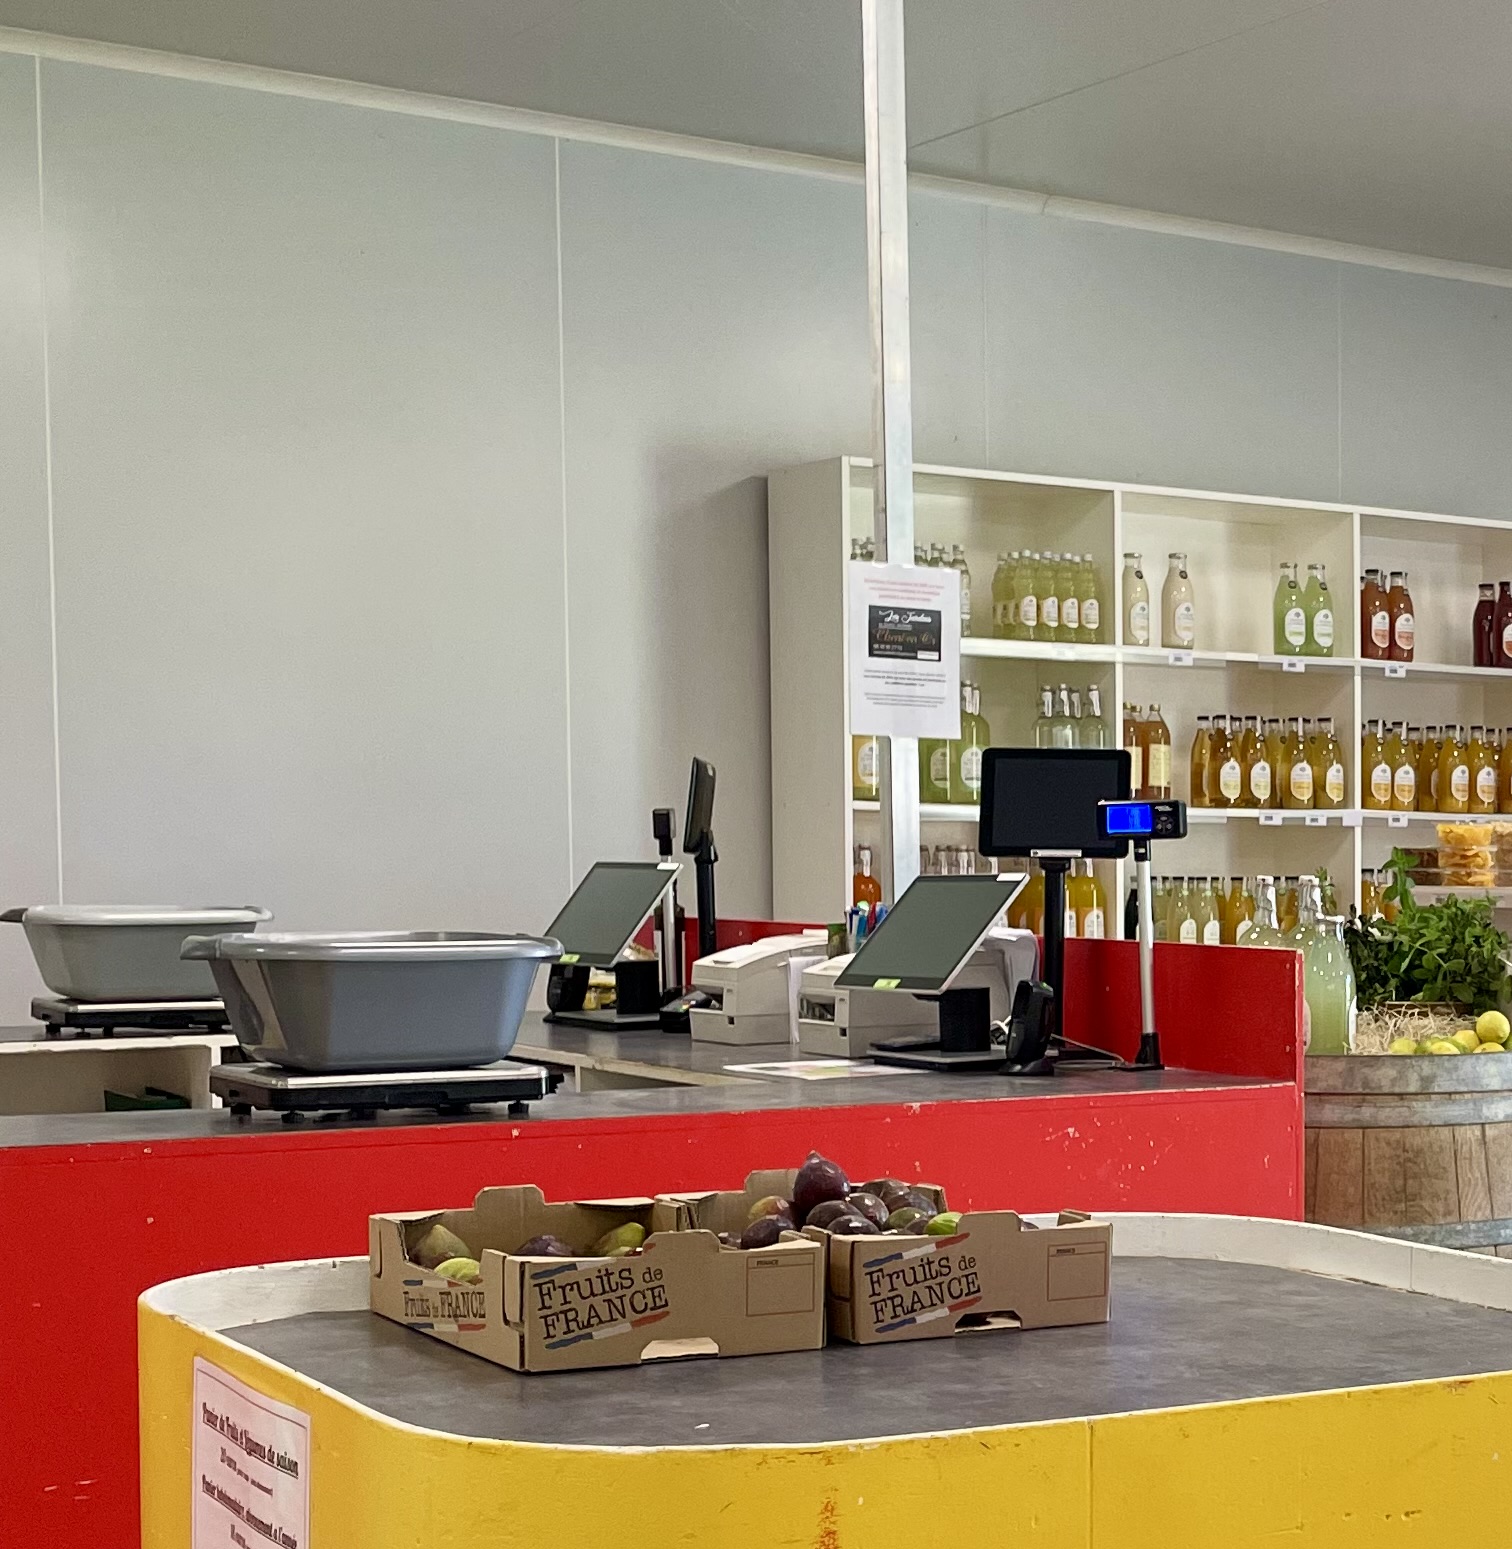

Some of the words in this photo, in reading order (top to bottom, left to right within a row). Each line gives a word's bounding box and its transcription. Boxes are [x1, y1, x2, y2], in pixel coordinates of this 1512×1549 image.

[532, 1266, 635, 1312] Fruits
[642, 1266, 664, 1284] de
[864, 1254, 952, 1299] Fruits
[957, 1254, 977, 1272] de
[869, 1272, 982, 1325] FRANCE
[402, 1291, 430, 1318] Fruits
[438, 1291, 486, 1319] FRANCE
[538, 1284, 670, 1340] FRANCE
[267, 1445, 275, 1465] de
[276, 1451, 298, 1477] saison
